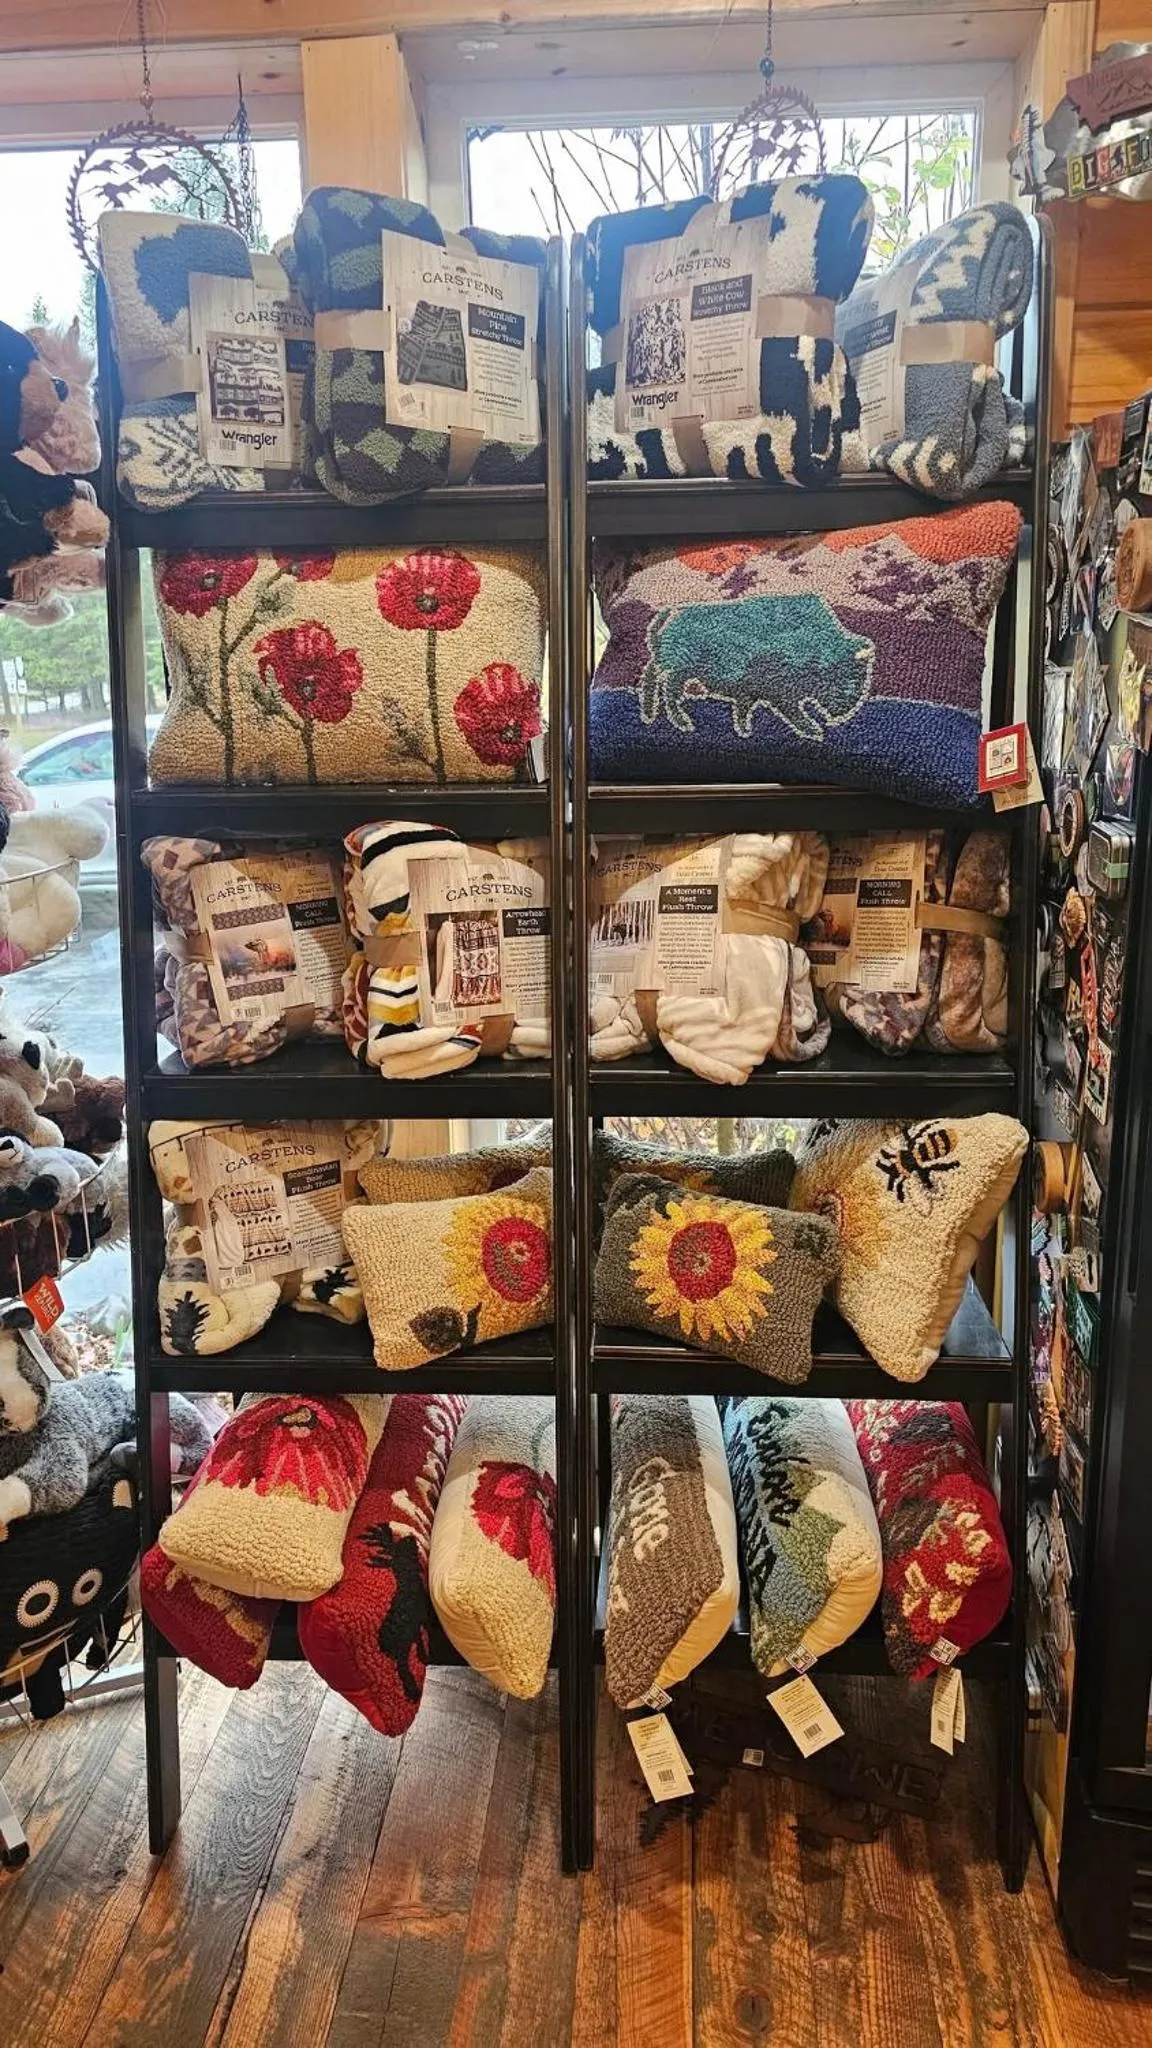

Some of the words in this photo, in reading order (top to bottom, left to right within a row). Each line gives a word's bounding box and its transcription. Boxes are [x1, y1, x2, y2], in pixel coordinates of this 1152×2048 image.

[654, 256, 732, 285] CARSTENS
[422, 271, 504, 301] CARSTENS
[725, 277, 744, 291] and
[698, 293, 724, 305] White
[725, 289, 746, 302] Cow
[234, 311, 314, 329] CARSTEN
[477, 306, 518, 325] Mountain
[632, 390, 679, 411] Wrangler
[222, 429, 279, 450] Wrangler
[596, 860, 663, 878] CARSTENS
[206, 882, 283, 904] CARSTENS
[446, 884, 534, 903] CARSTENS
[673, 887, 713, 896] Moment's
[866, 881, 902, 889] MORNING
[661, 903, 685, 911] Plush
[686, 903, 714, 911] Throw
[515, 927, 541, 935] Throw
[517, 918, 539, 927] Earth
[225, 1144, 317, 1174] CARSTENS
[287, 1162, 338, 1180] Scandinavian
[291, 1183, 314, 1194] Plush
[315, 1178, 337, 1189] Throw
[38, 1282, 60, 1318] WILD
